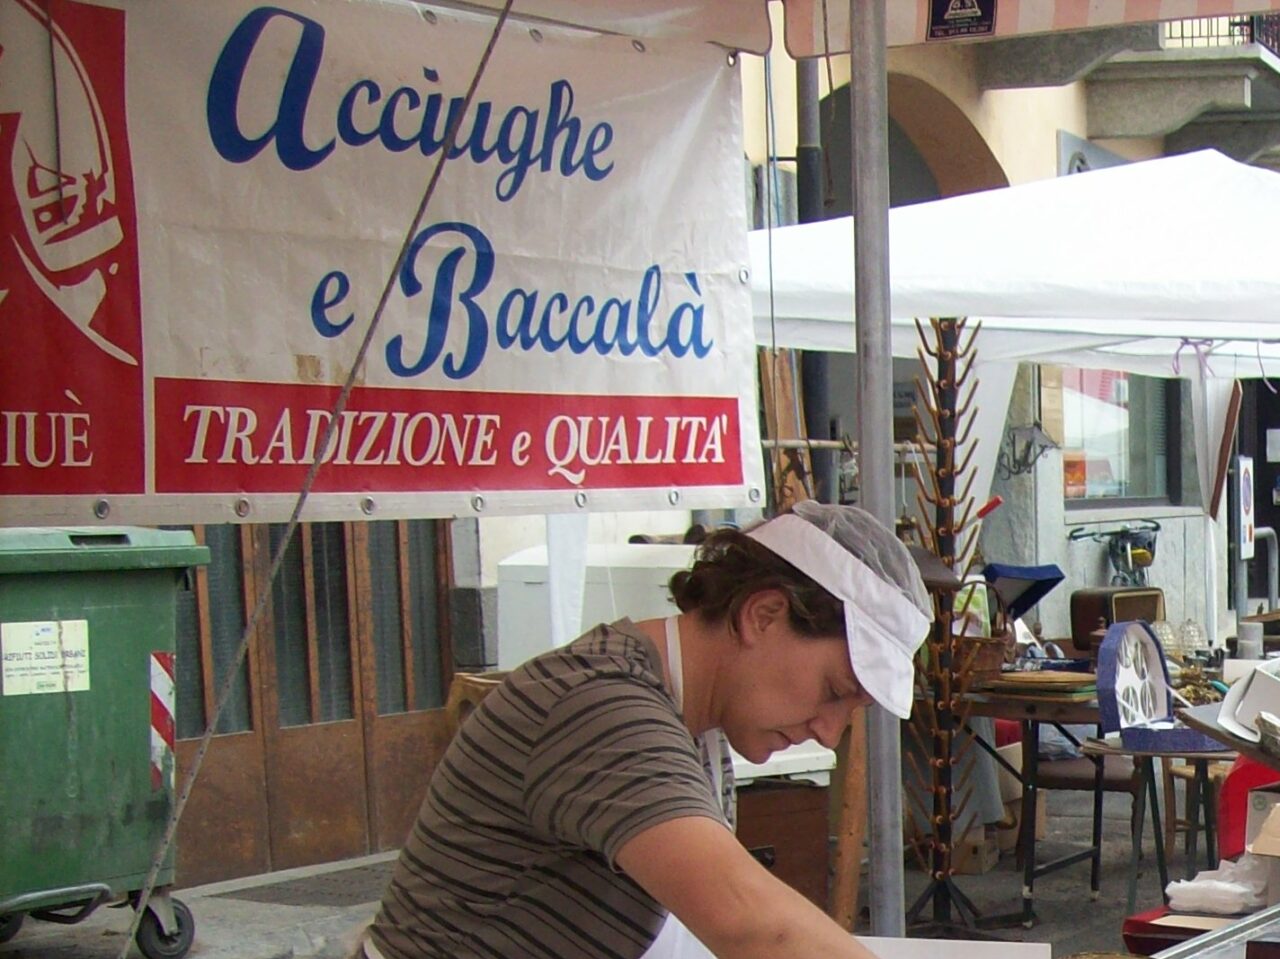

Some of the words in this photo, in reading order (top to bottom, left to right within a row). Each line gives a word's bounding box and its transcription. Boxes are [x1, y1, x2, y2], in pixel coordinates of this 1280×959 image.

[206, 5, 615, 202] Acciughe
[310, 270, 355, 338] e
[384, 221, 714, 380] Baccalà
[1, 390, 94, 468] IUÈ
[182, 404, 501, 466] TRADIZIONE
[511, 433, 530, 467] e
[545, 415, 729, 485] QUALITA'
